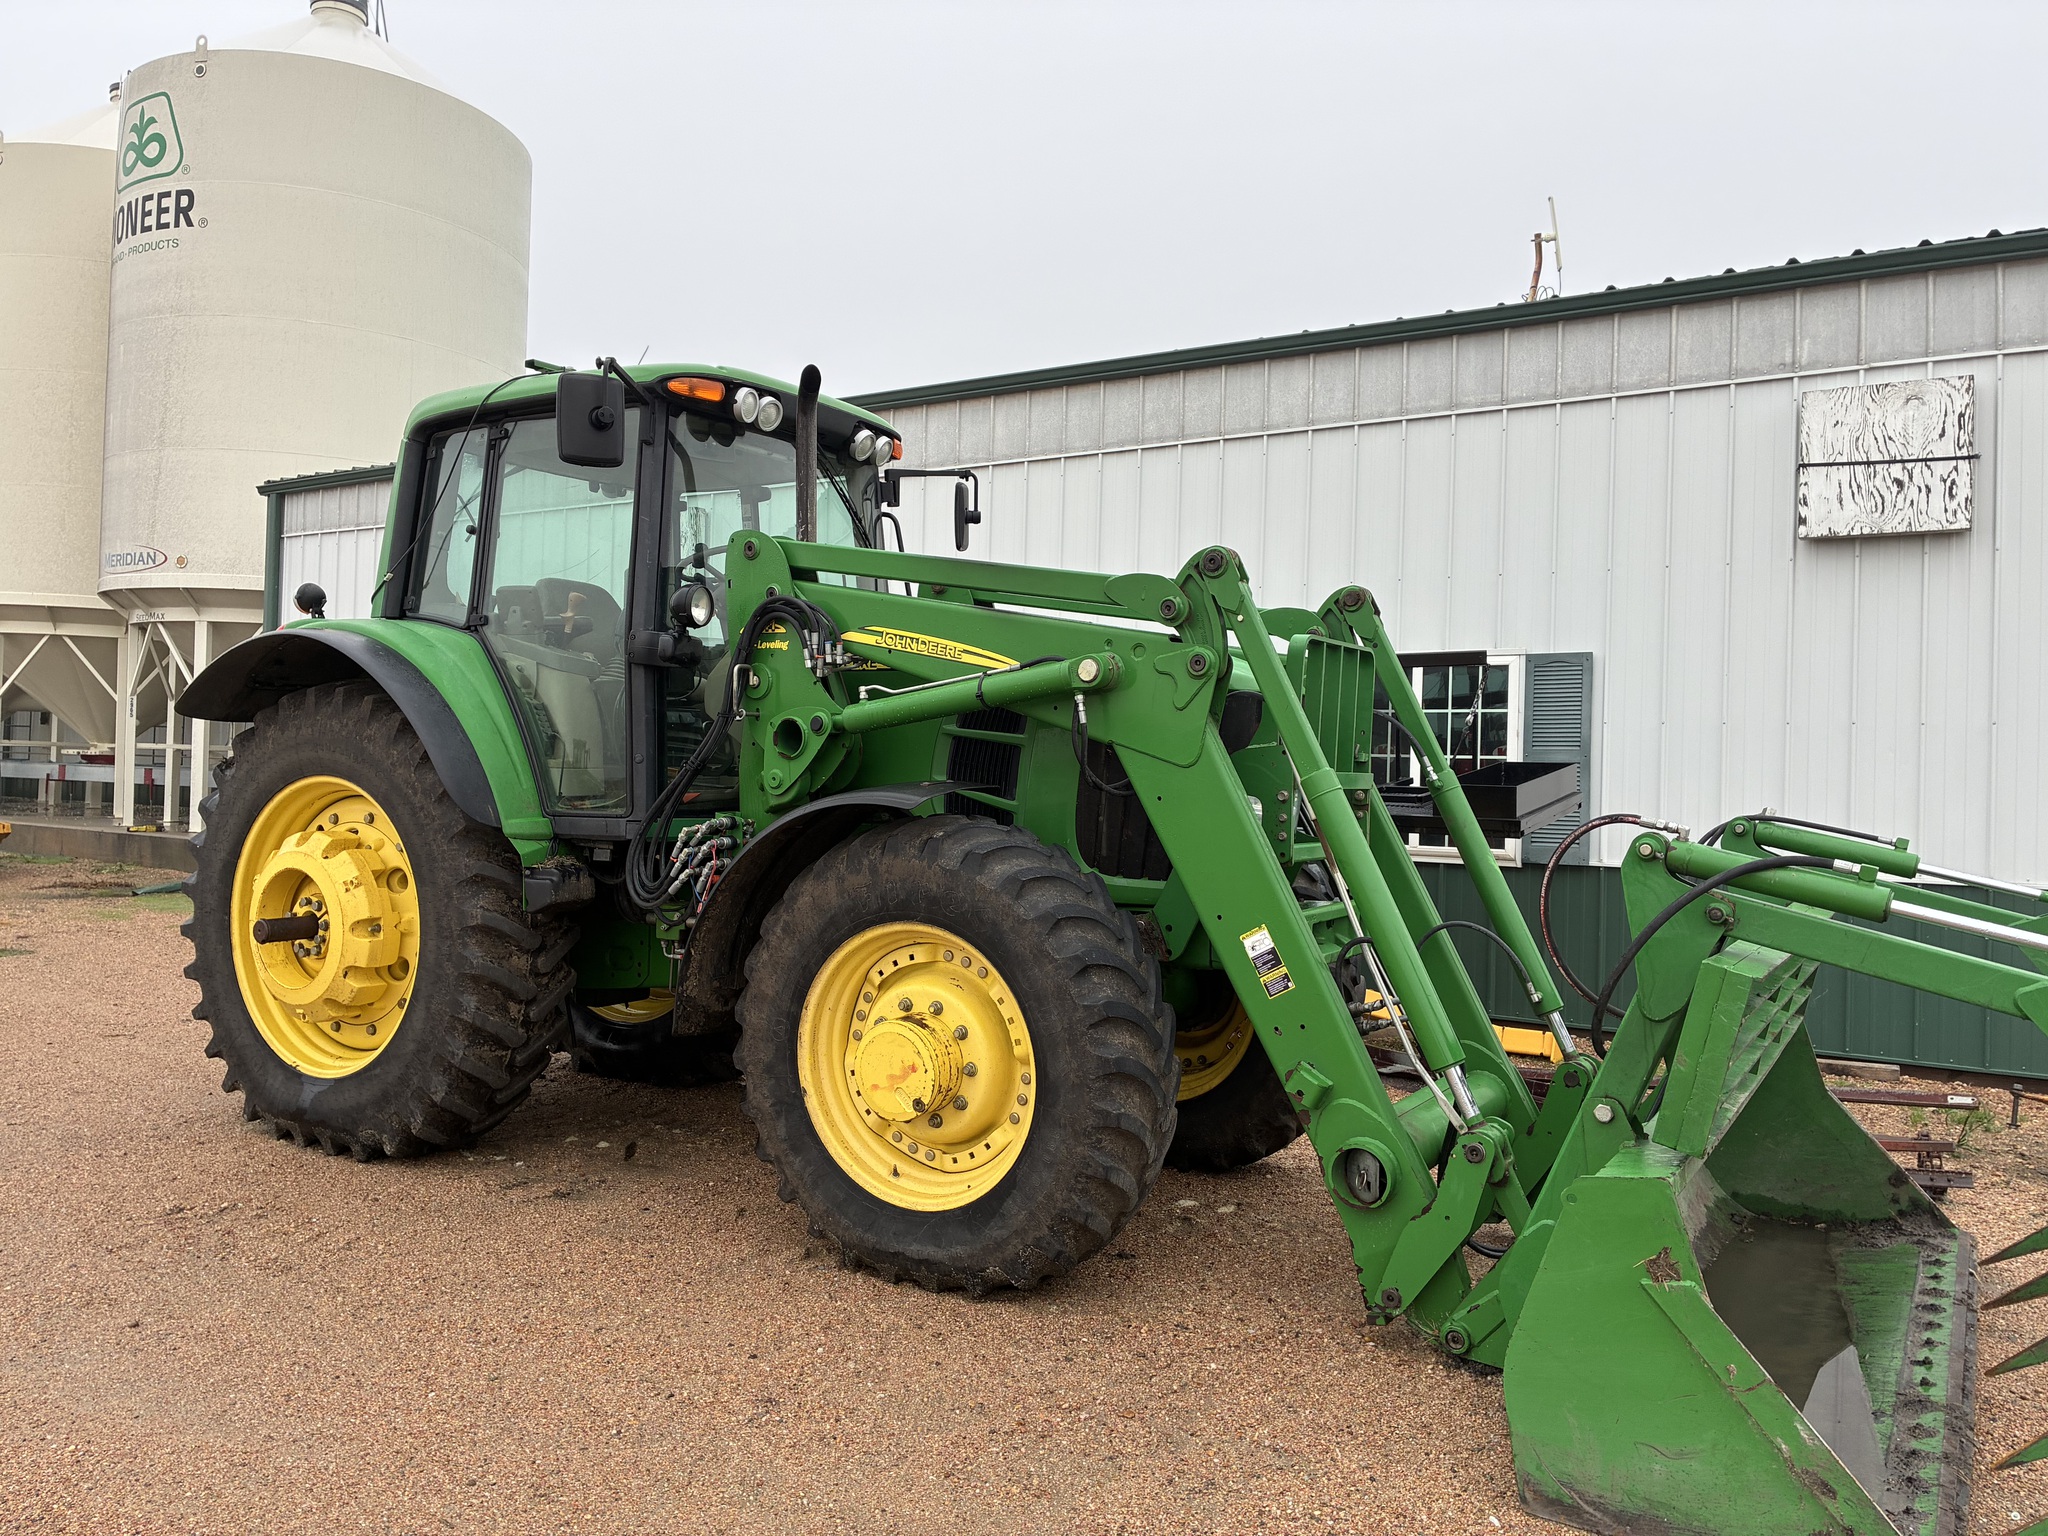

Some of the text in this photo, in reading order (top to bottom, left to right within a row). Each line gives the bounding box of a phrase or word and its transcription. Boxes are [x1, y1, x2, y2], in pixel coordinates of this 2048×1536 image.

[127, 238, 179, 257] PRODUCTS
[104, 551, 157, 569] MERIDIAN
[876, 630, 964, 659] JOHN DEERE
